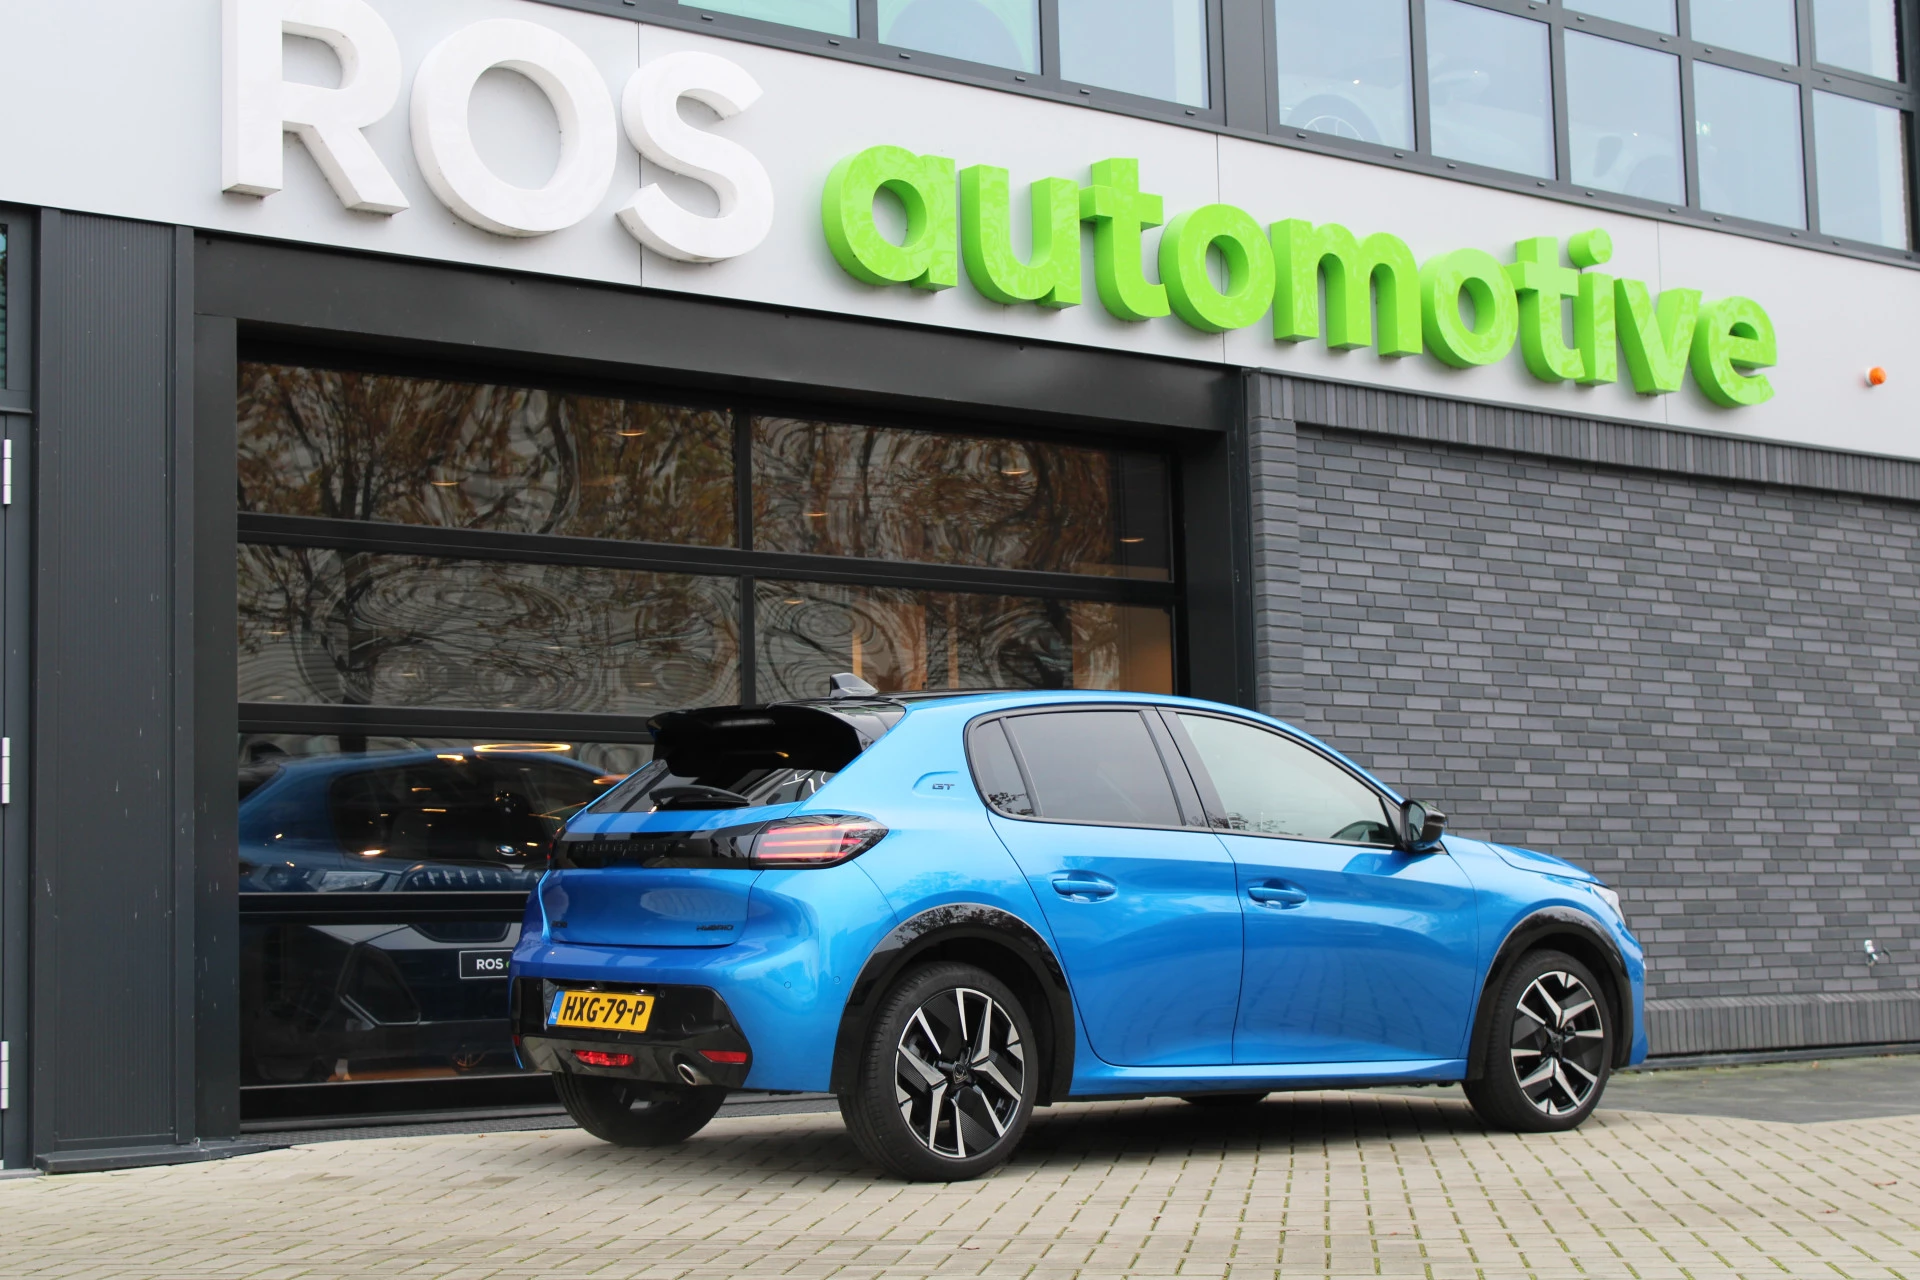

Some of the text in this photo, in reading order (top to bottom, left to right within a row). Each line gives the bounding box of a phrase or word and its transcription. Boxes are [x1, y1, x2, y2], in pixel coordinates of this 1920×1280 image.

[222, 0, 1776, 407] ROS automotive
[476, 958, 504, 970] ROS
[562, 996, 646, 1025] HXG-79-P
